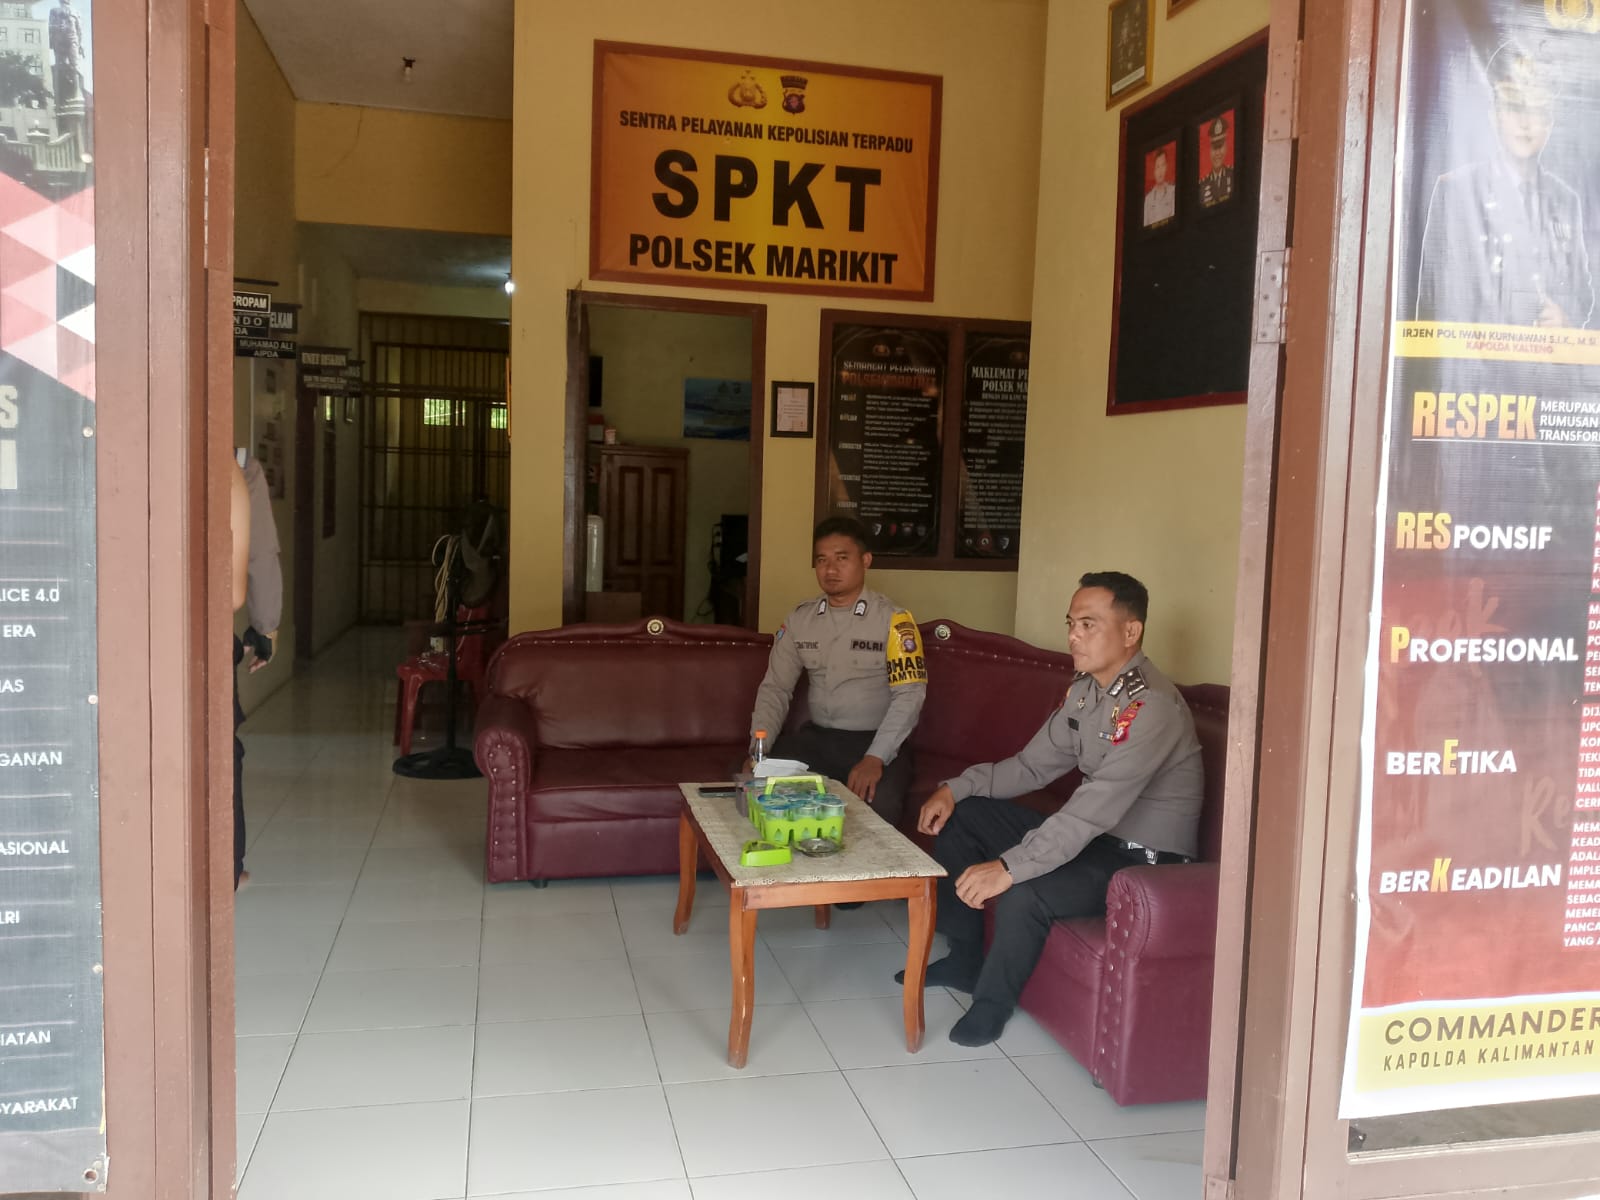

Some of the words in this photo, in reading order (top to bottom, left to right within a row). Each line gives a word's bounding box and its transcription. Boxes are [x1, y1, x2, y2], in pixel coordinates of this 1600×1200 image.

[620, 110, 677, 131] SENTRA
[681, 117, 763, 139] PELAYANAN
[767, 125, 849, 147] KEPOLISIAN
[852, 133, 913, 153] TERPADU
[652, 149, 882, 233] SPKT
[629, 233, 755, 275] POLSEK
[766, 245, 898, 285] MARIKIT
[1402, 328, 1434, 338] IRJEN
[1459, 329, 1486, 340] IWAN
[1489, 331, 1547, 343] KURNIAWAN
[1466, 341, 1510, 352] KAPOLDA
[1513, 344, 1554, 354] KALTENG
[982, 380, 1014, 392] POLSEK
[1412, 392, 1537, 440] RESPEK
[1540, 415, 1599, 428] RUMUSAN
[1539, 430, 1600, 442] TRANSFOR
[1396, 511, 1552, 550] RESPONSIF
[35, 588, 60, 602] 4.0
[3, 624, 36, 638] ERA
[852, 641, 883, 651] POLRI
[1390, 626, 1579, 663] PROFESIONAL
[887, 655, 925, 674] BHAB
[1386, 739, 1518, 776] BERETIKA
[1570, 851, 1600, 861] ADAL
[1380, 857, 1562, 894] BERKEADILAN
[1563, 936, 1594, 947] YANG
[1385, 1007, 1600, 1045] COMMANDER
[1383, 1050, 1466, 1072] KAPOLDA
[1477, 1040, 1595, 1065] KALIMANTAN
[0, 1097, 79, 1115] YARAKAT
